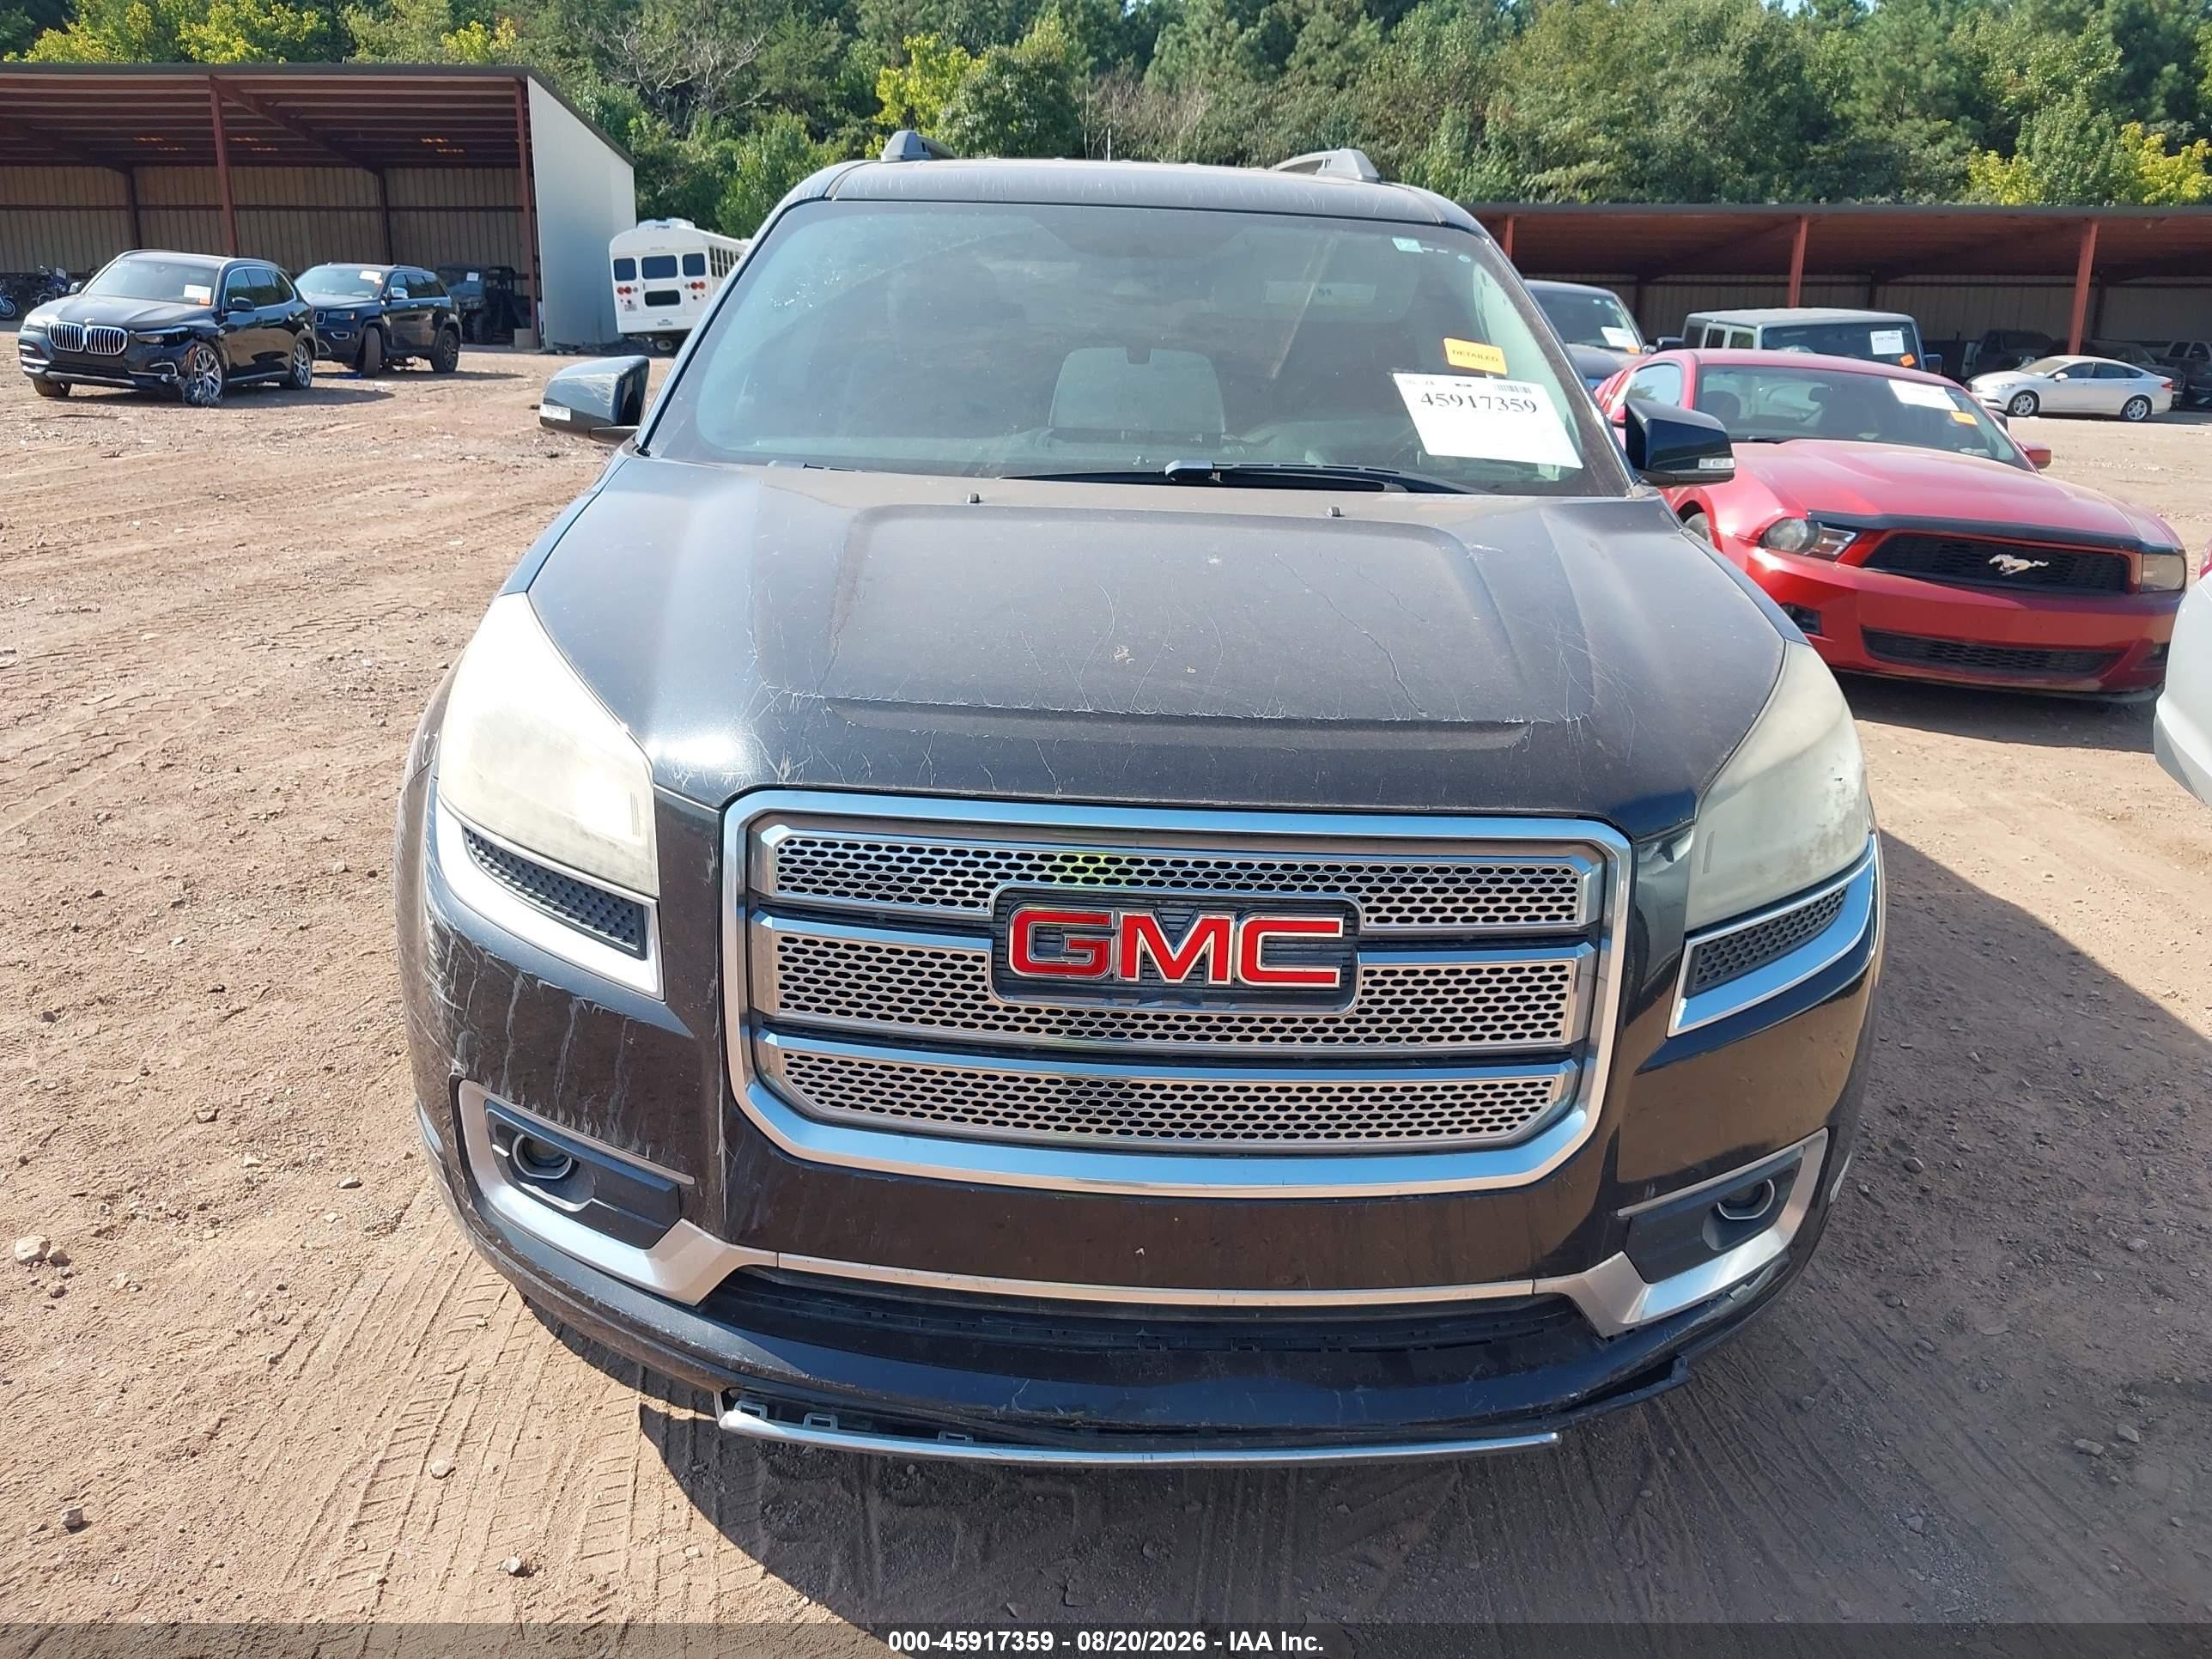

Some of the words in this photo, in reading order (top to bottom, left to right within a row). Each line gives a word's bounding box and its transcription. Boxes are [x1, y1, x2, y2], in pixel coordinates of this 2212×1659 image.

[1451, 349, 1499, 362] DETAILED
[1420, 392, 1538, 413] 45917359
[1008, 907, 1346, 988] GMC
